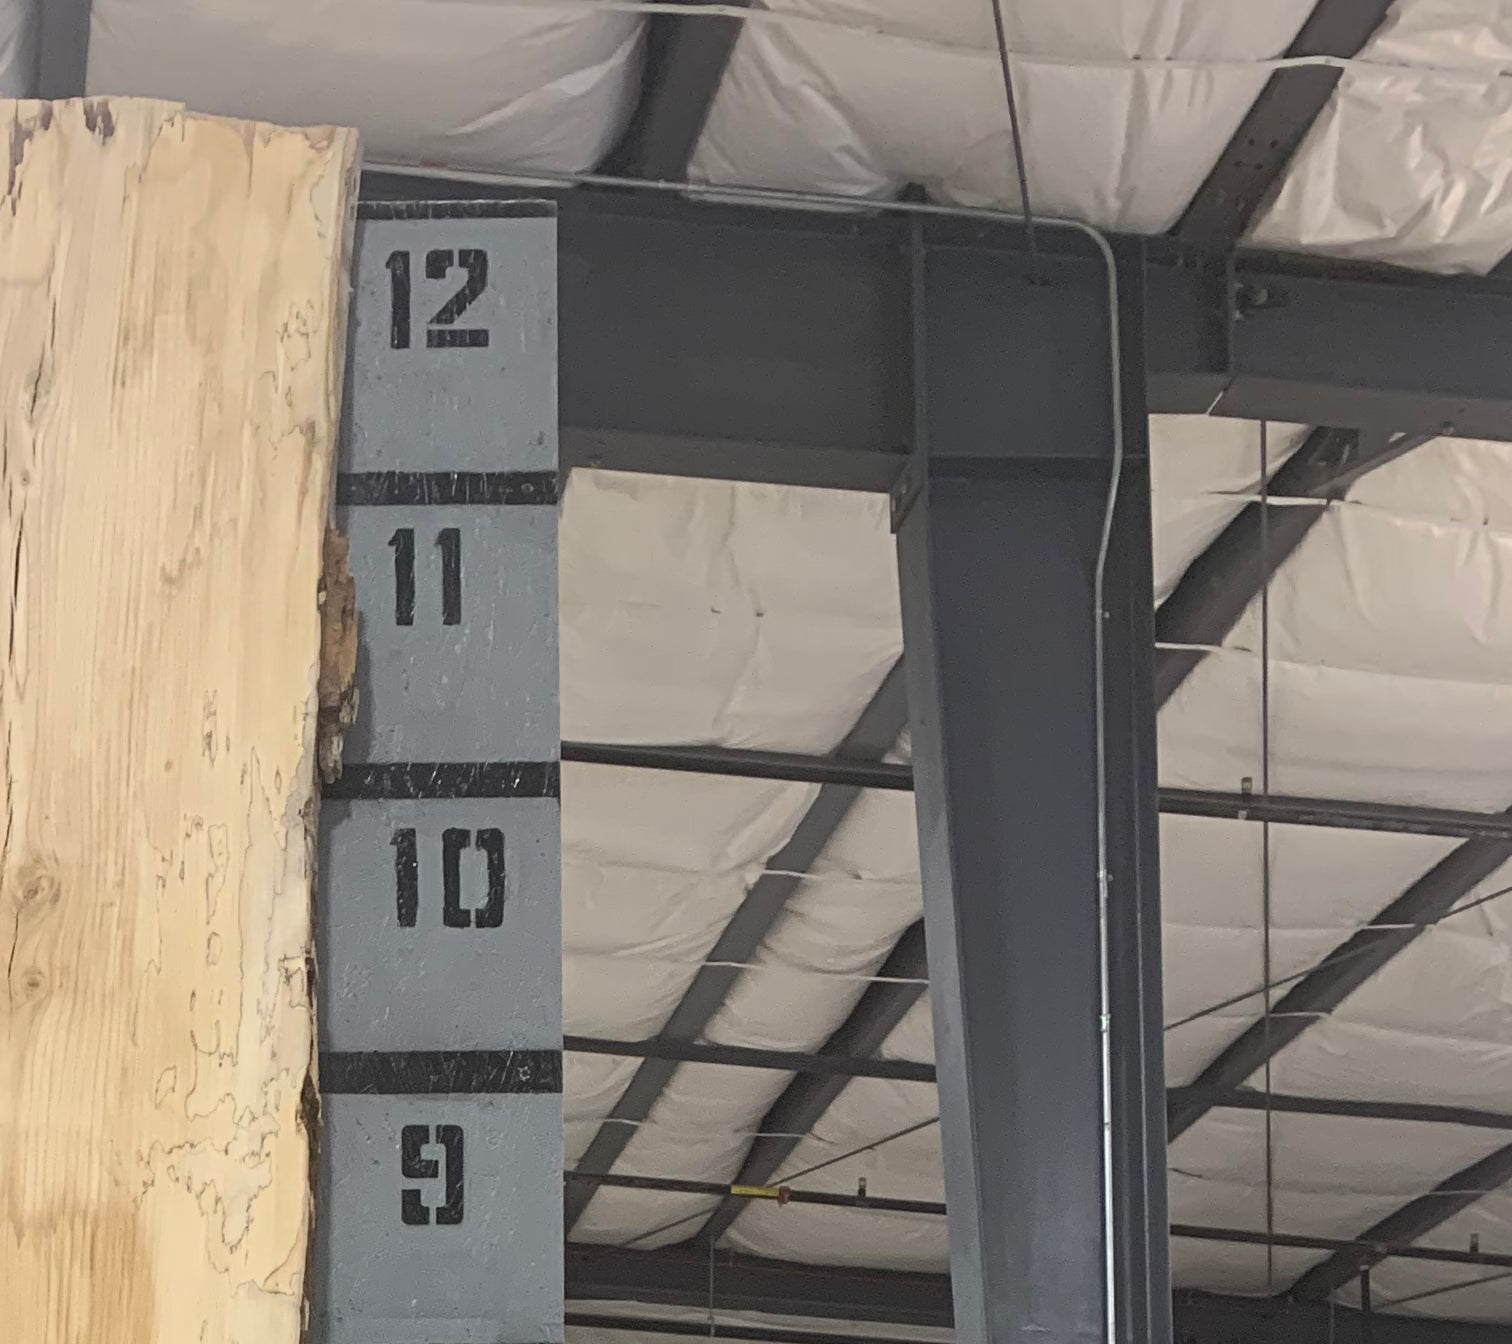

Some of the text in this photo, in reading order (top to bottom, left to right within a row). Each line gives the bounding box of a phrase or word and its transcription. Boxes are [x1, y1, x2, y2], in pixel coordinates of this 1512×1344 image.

[386, 249, 489, 349] 12
[387, 527, 462, 626] 11
[389, 827, 506, 929] 10
[401, 1124, 464, 1226] 9
